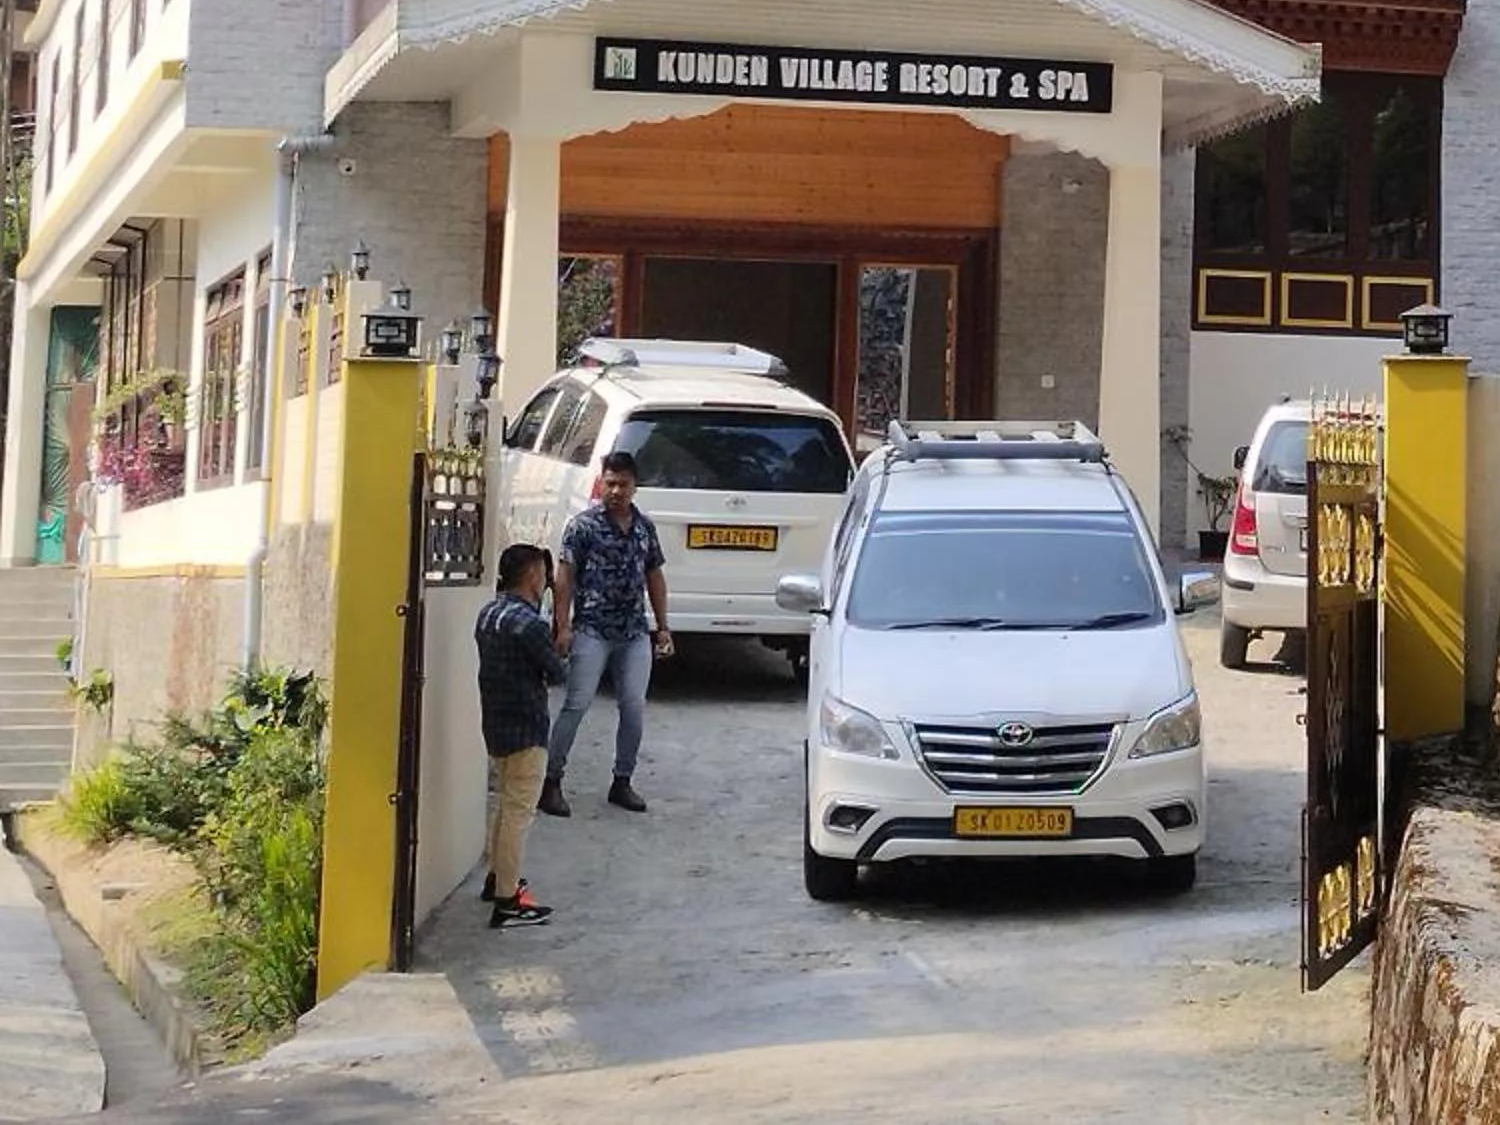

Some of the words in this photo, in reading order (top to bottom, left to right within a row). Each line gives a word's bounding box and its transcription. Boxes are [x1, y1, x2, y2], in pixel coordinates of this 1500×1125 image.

[658, 51, 768, 86] KUNDEN
[780, 57, 889, 92] VILLAGE
[900, 62, 1001, 97] RESORT
[1009, 72, 1030, 98] &
[1038, 69, 1089, 102] SPA
